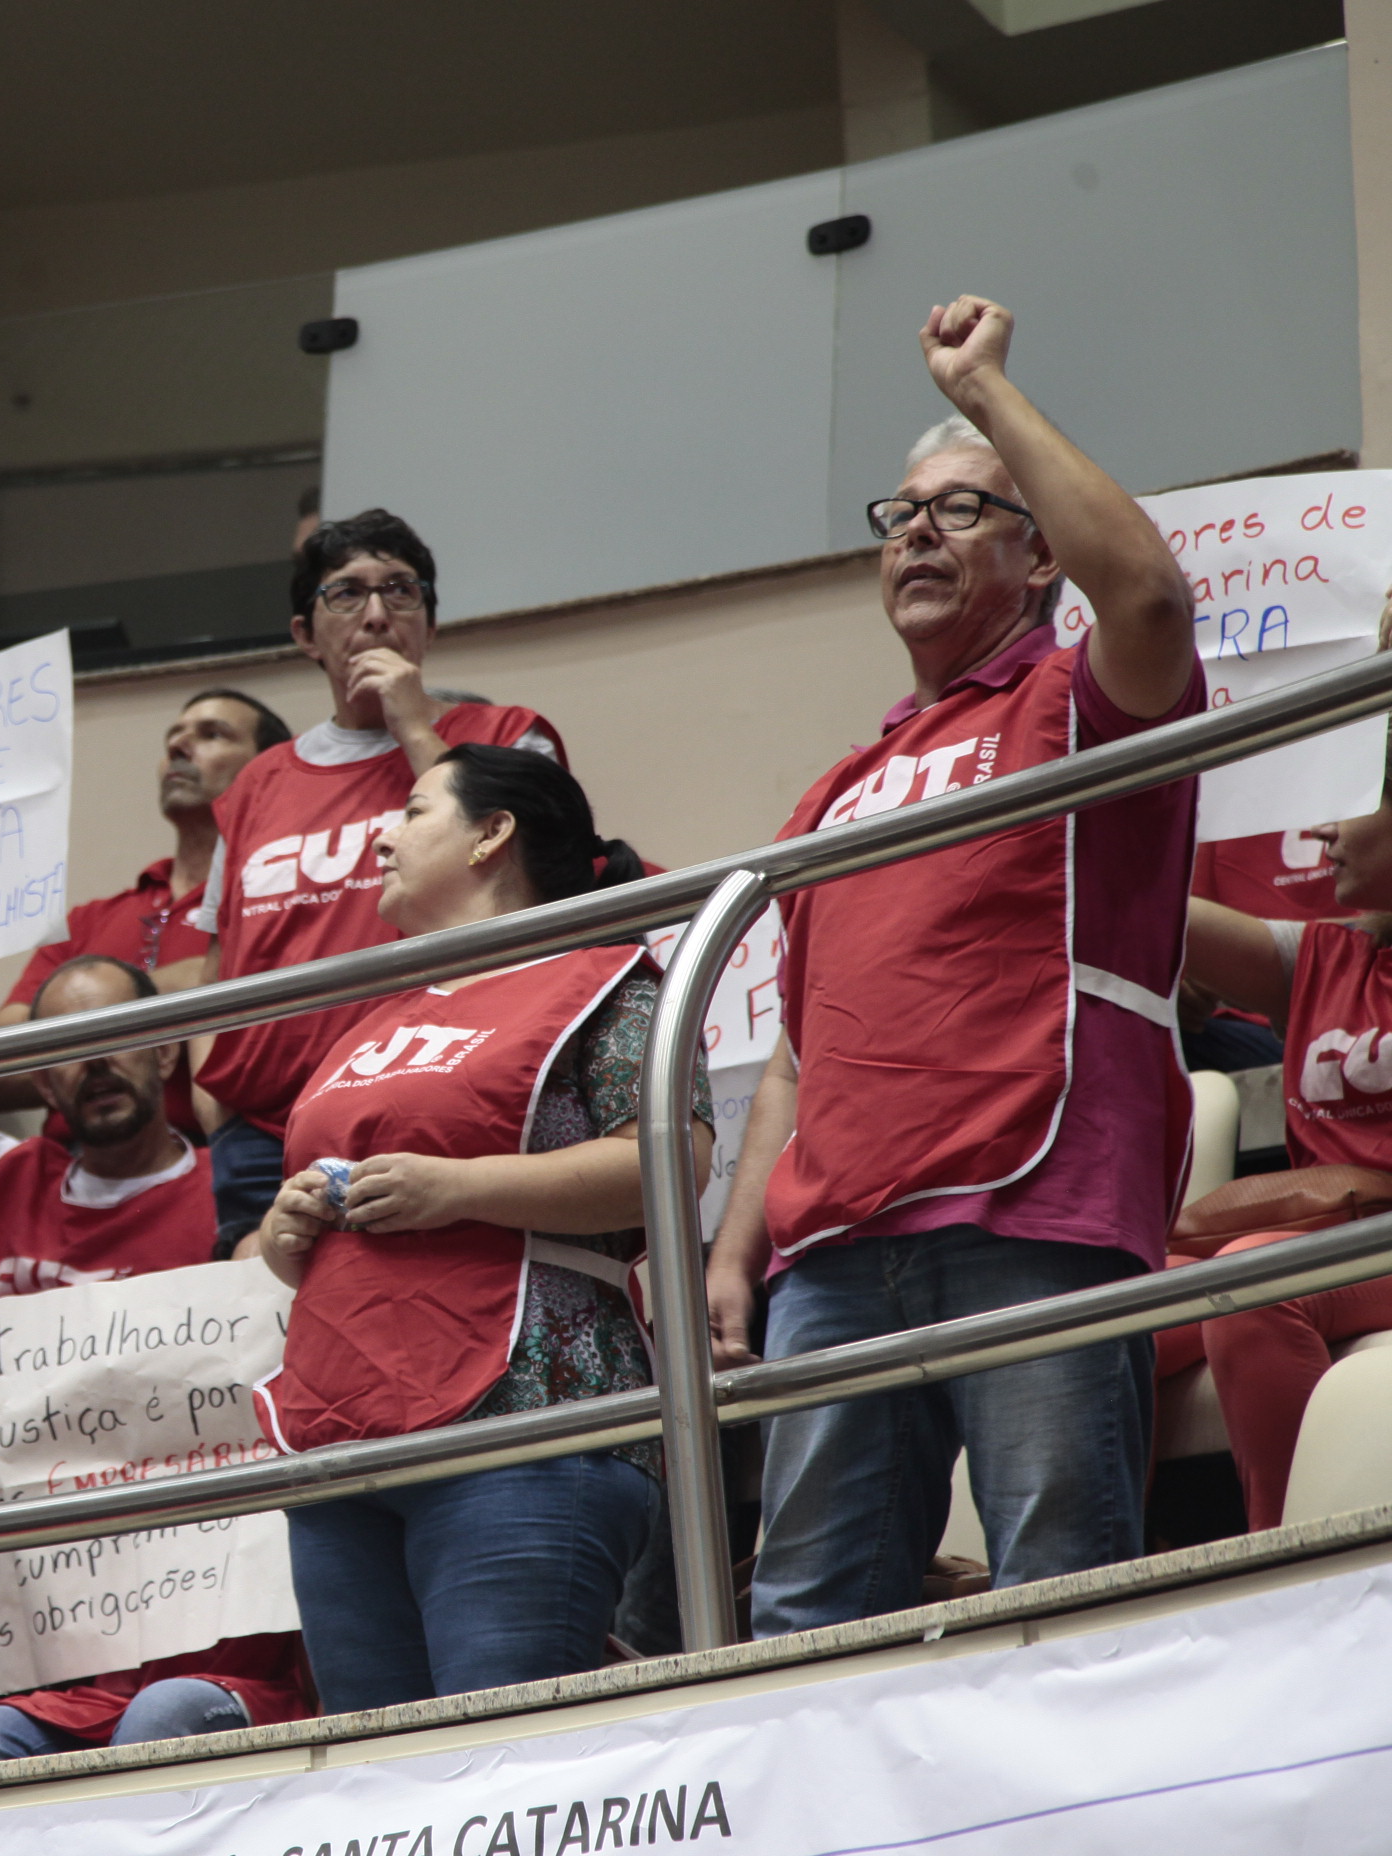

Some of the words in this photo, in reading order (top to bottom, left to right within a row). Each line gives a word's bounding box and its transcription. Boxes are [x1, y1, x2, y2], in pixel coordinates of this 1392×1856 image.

[1301, 493, 1366, 531] de
[1190, 554, 1329, 604] arina
[973, 732, 1001, 785] RASIL
[445, 1027, 497, 1068] BRASIL
[1300, 1026, 1392, 1103] CU
[146, 1386, 165, 1423] é
[454, 1781, 733, 1856] CATARINA
